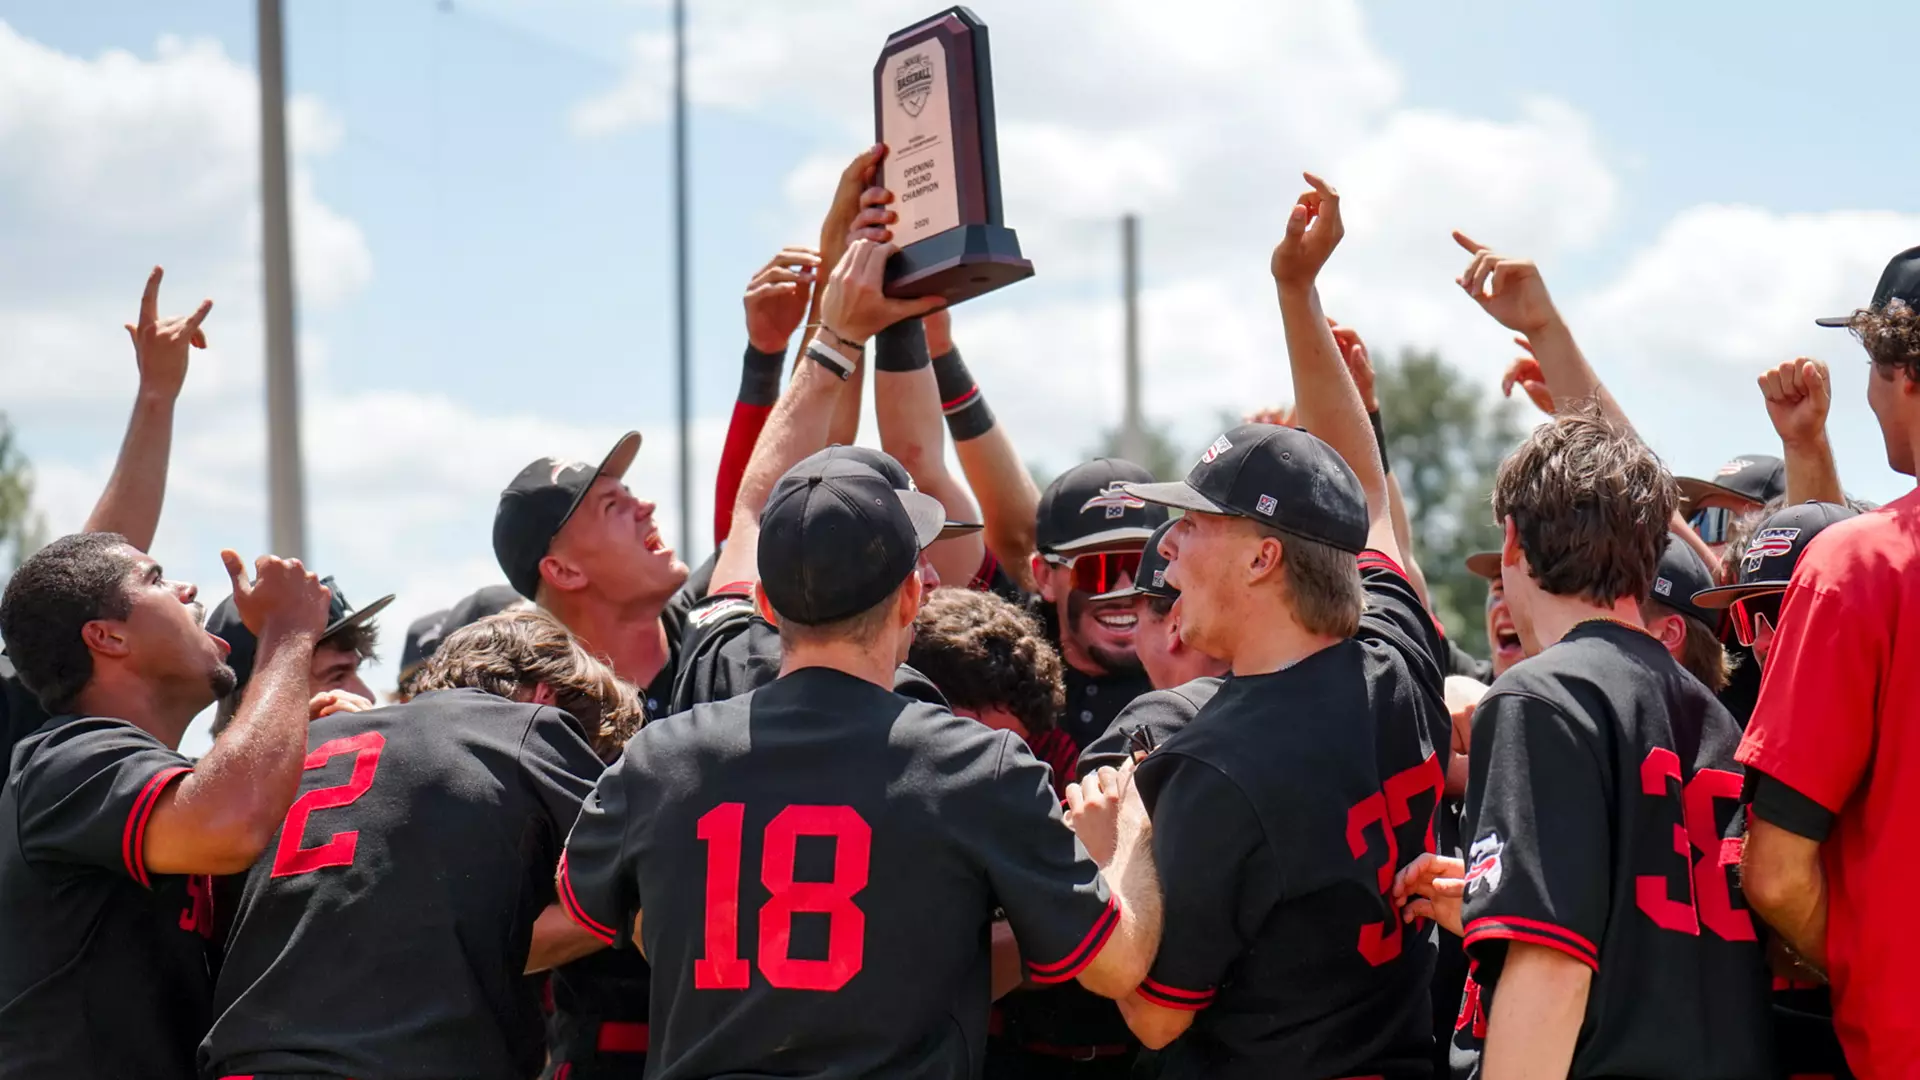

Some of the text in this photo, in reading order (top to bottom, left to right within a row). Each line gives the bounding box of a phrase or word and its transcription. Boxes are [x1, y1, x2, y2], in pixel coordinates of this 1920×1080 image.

[897, 67, 932, 91] BASEBALL
[902, 181, 939, 203] CHAMPION
[903, 159, 935, 178] OPENING
[907, 172, 932, 189] ROUND
[270, 730, 386, 878] 2
[1635, 746, 1759, 942] 38
[694, 802, 872, 991] 18
[1345, 751, 1445, 967] 37
